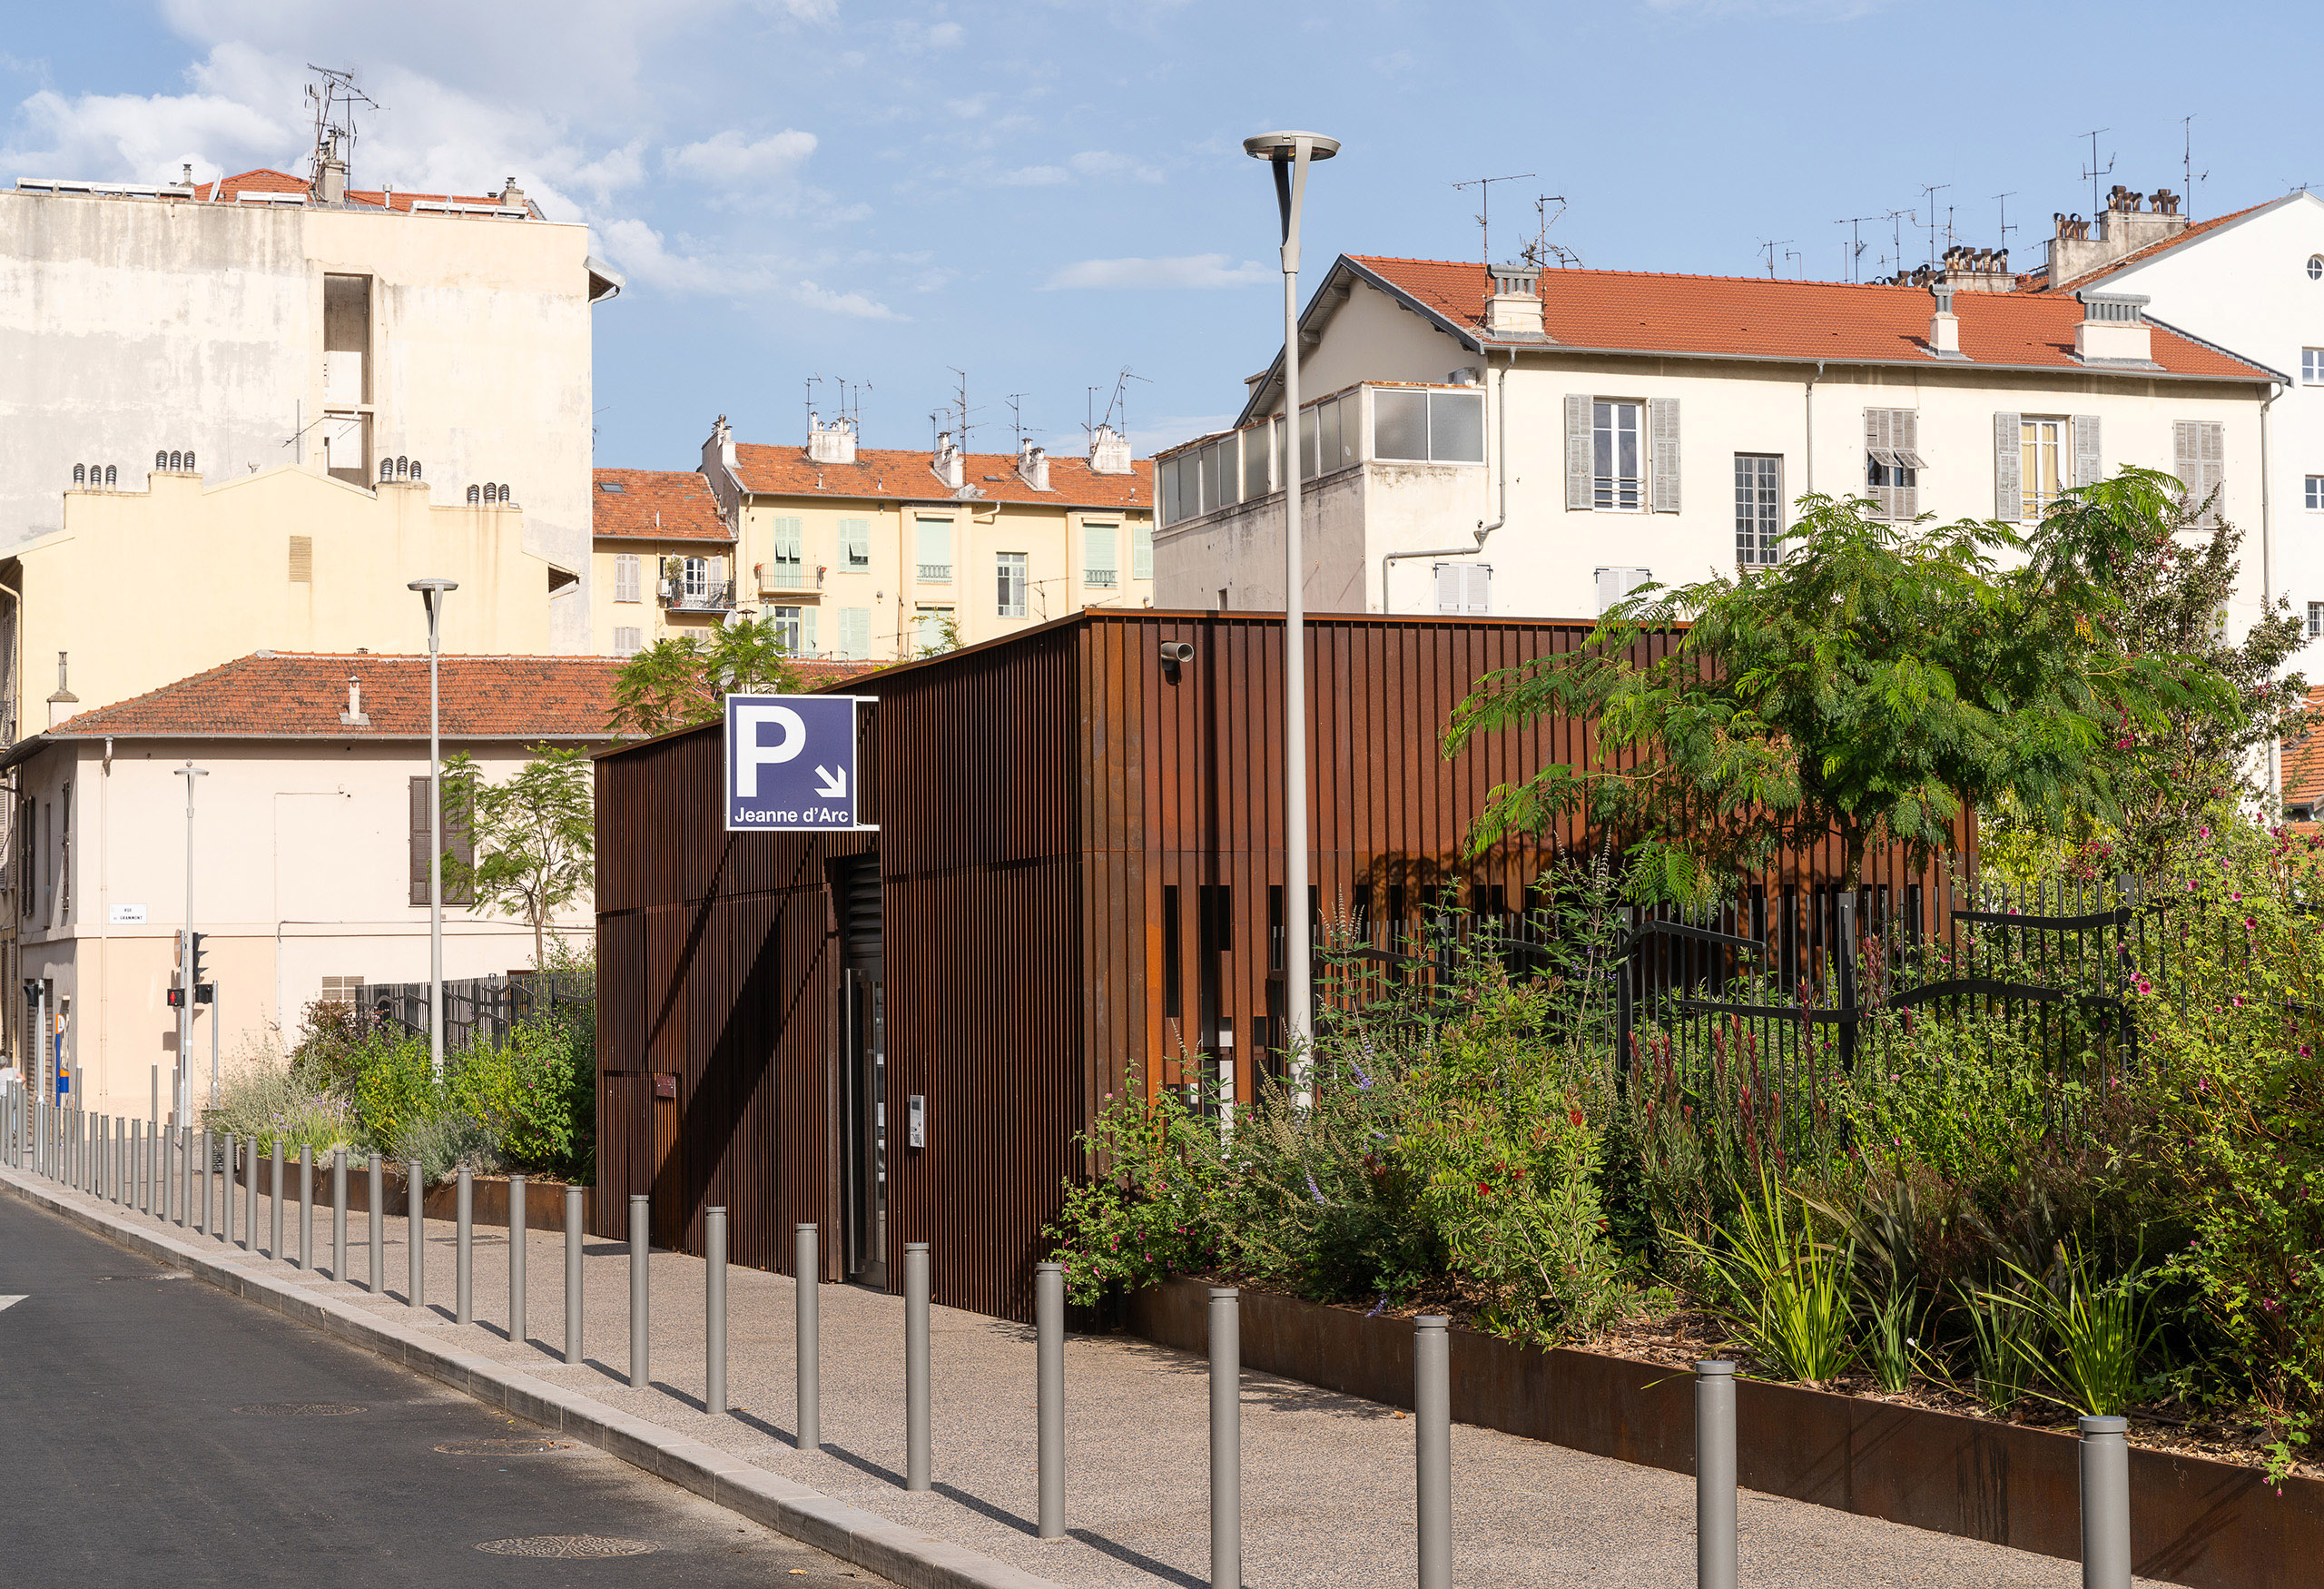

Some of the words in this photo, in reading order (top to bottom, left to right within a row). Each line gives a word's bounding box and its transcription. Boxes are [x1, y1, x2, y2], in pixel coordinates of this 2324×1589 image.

[735, 706, 806, 797] P
[734, 806, 798, 823] Jeanne
[803, 806, 849, 823] d'Arc
